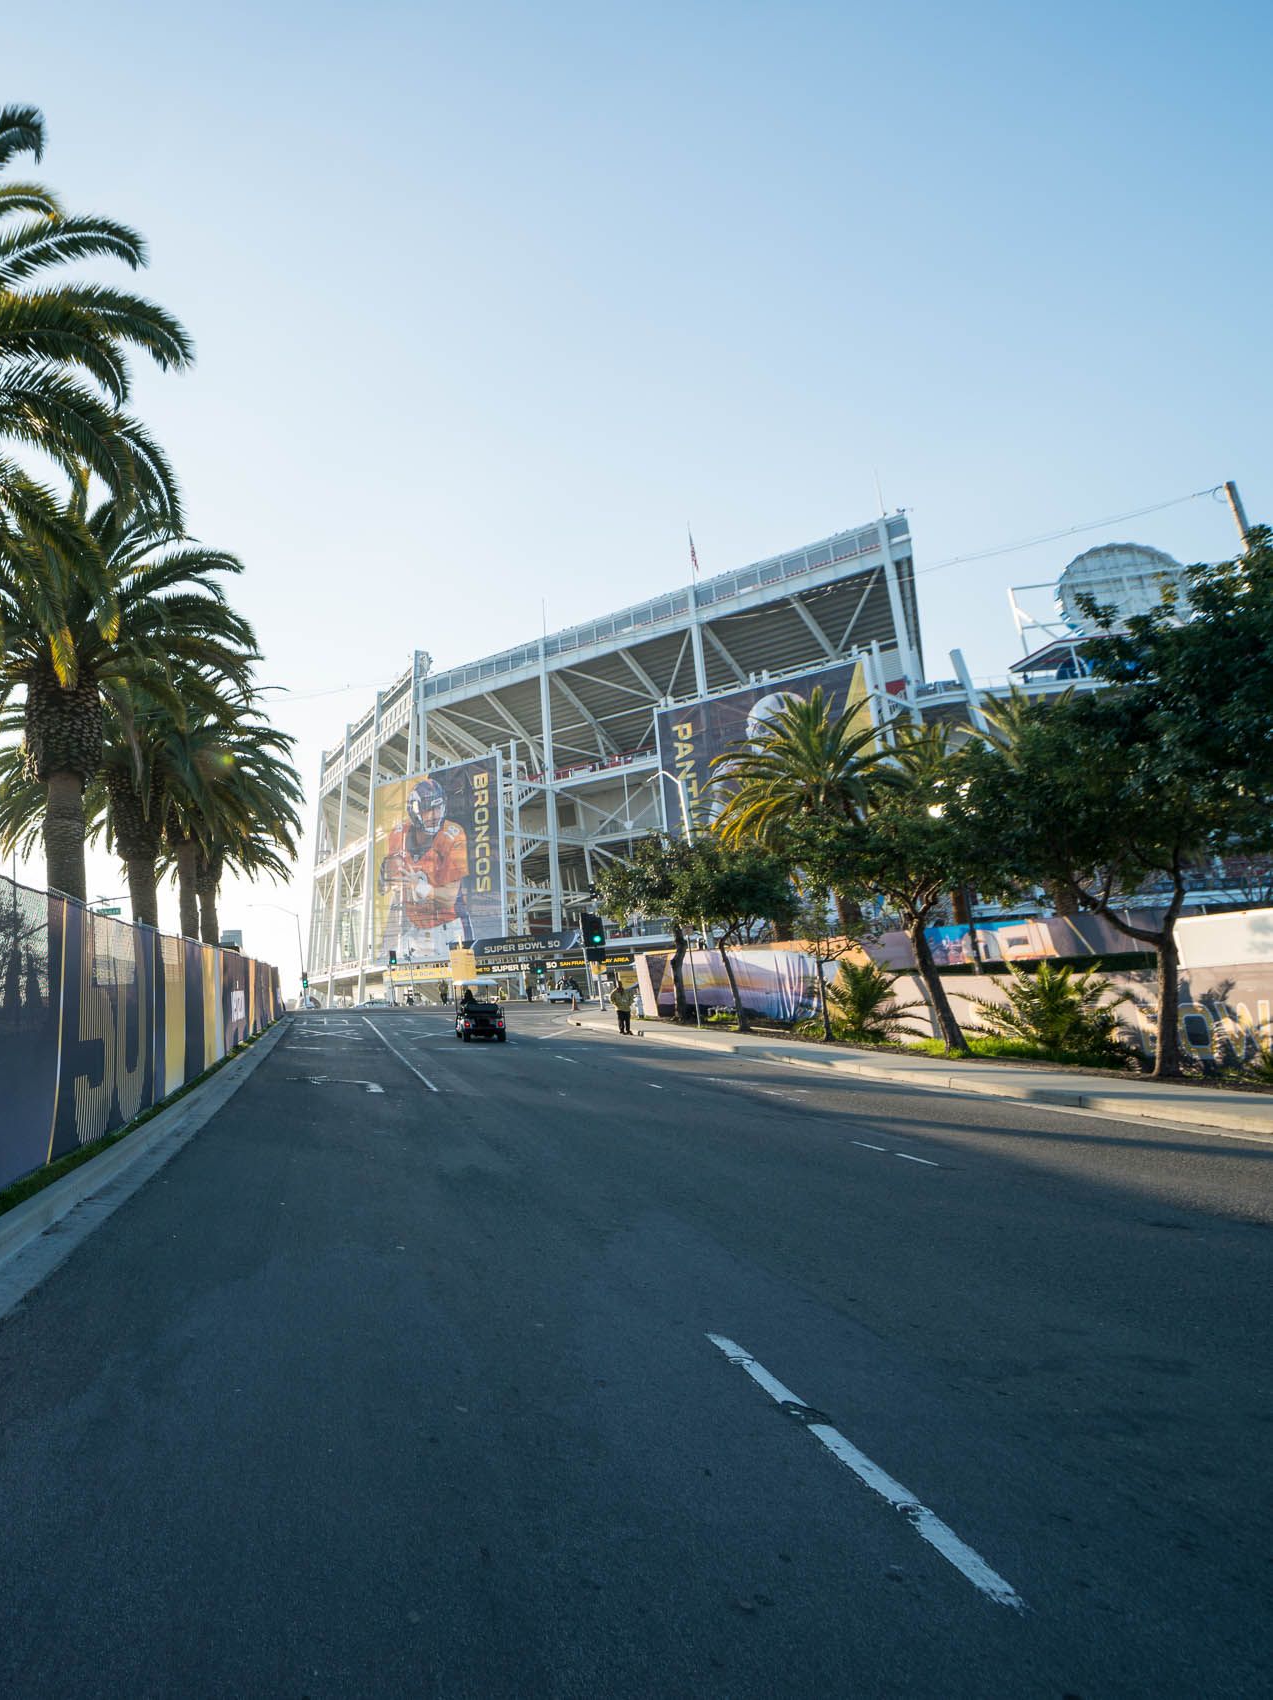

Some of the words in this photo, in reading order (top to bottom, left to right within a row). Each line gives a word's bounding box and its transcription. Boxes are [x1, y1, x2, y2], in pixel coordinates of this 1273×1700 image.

[473, 772, 492, 892] BRONCOS
[484, 943, 515, 953] SUPER
[518, 942, 545, 951] BOWL
[548, 940, 560, 948] 50
[492, 965, 519, 973] SUPER
[75, 905, 147, 1146] 50
